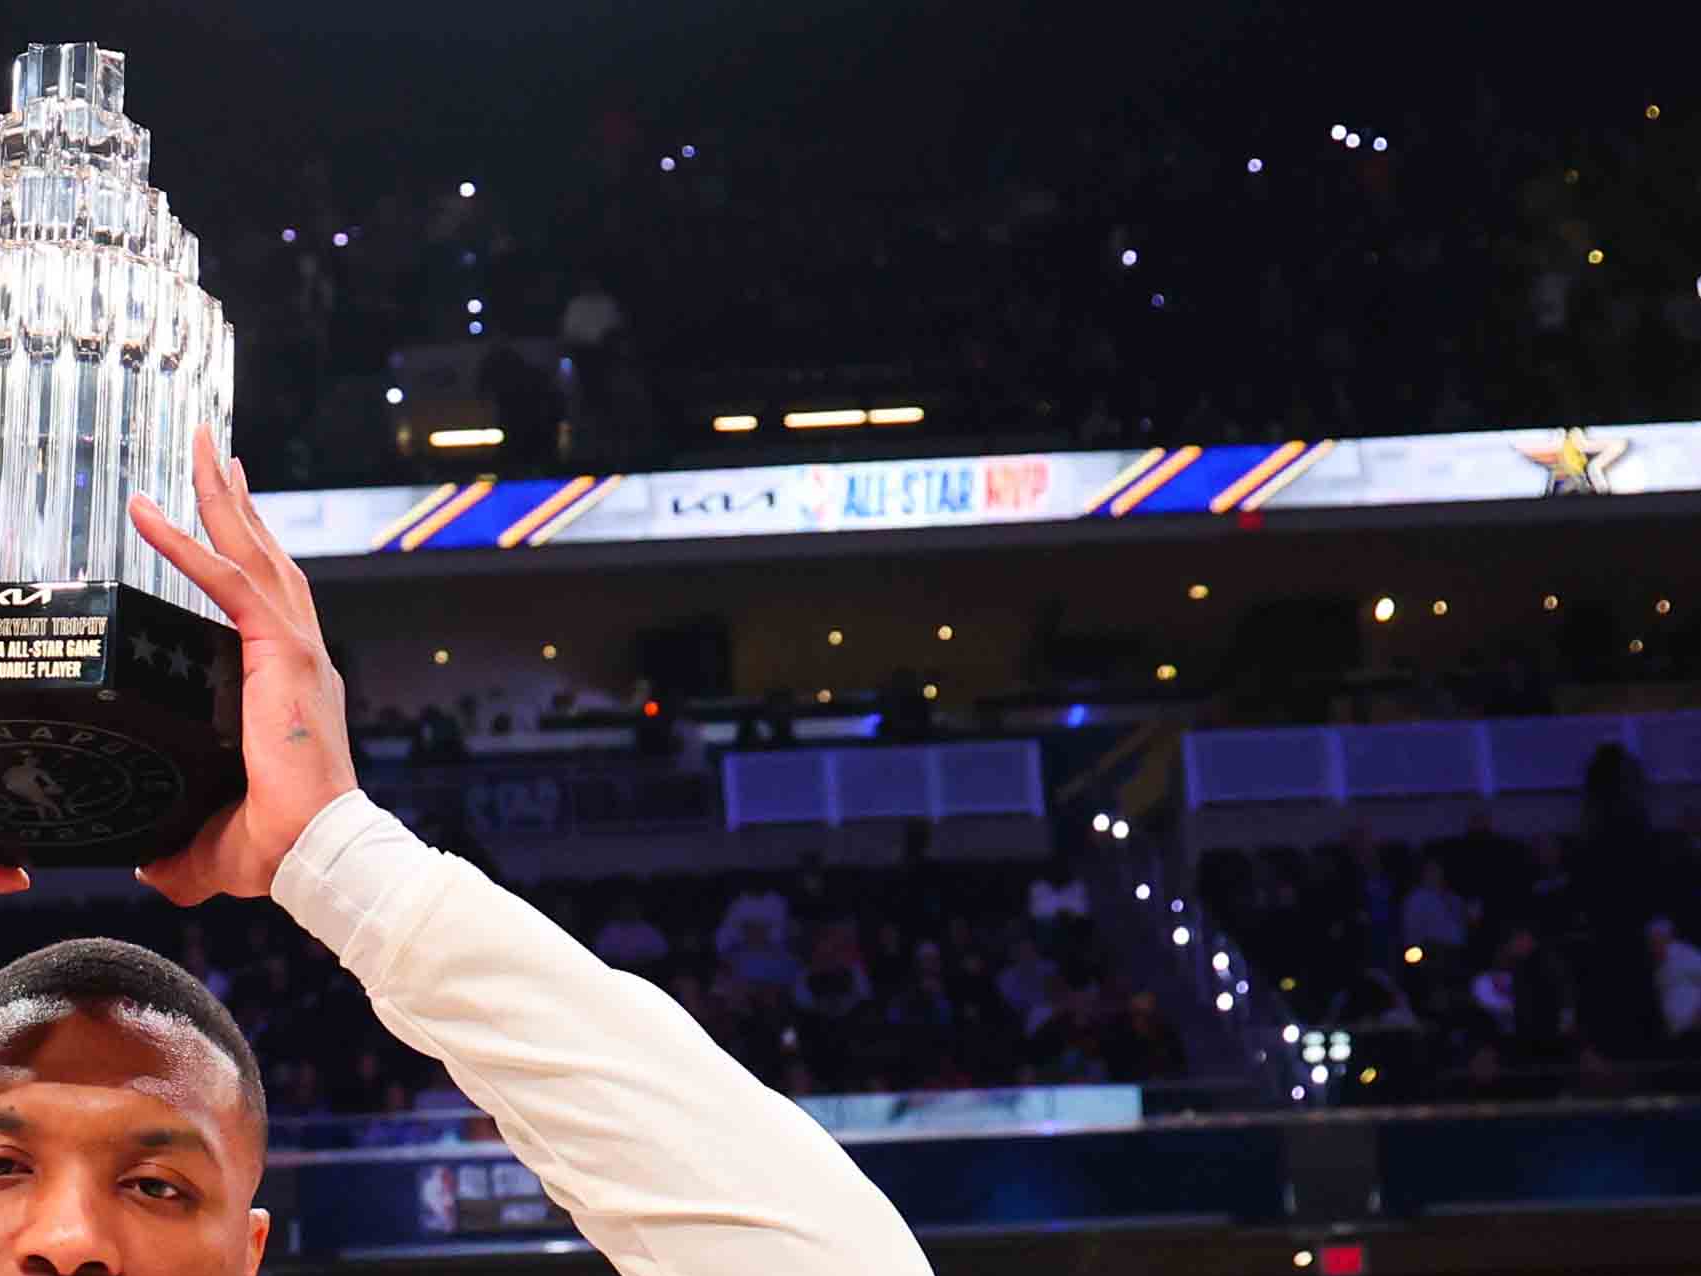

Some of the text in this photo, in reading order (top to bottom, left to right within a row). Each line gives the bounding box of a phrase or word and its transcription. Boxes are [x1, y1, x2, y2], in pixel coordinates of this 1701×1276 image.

[52, 616, 108, 636] TROPHY
[7, 640, 64, 658] ALL-STAR
[66, 639, 102, 657] GAME
[37, 660, 82, 678] PLAYER
